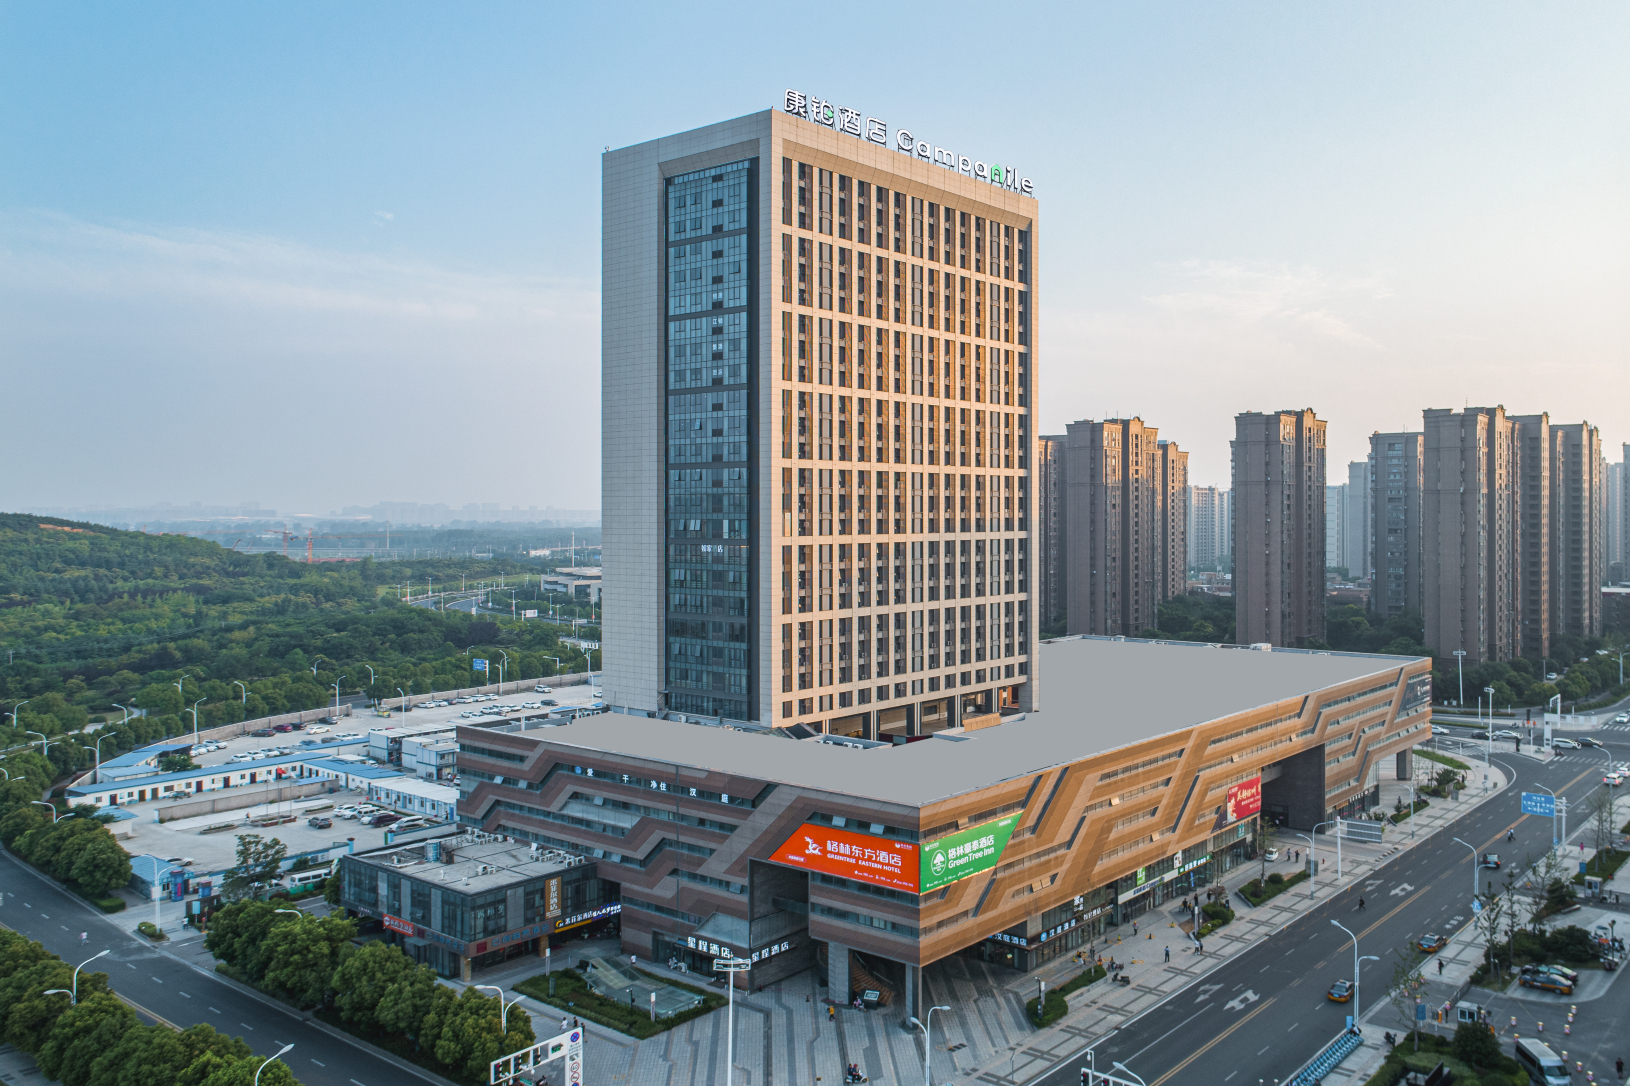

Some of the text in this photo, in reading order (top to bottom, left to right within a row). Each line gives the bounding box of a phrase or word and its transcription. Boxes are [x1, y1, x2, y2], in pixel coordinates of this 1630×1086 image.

[784, 88, 1034, 192] 康铂酒店 Campanile
[826, 839, 902, 867] 格林东方酒店
[948, 834, 995, 860] 格林豪泰酒店
[983, 846, 995, 857] Inn
[826, 853, 902, 874] GREENTREE EASTERN HOTEL
[1049, 918, 1076, 938] 汉庭酒店
[994, 932, 1028, 947] 汉庭酒店
